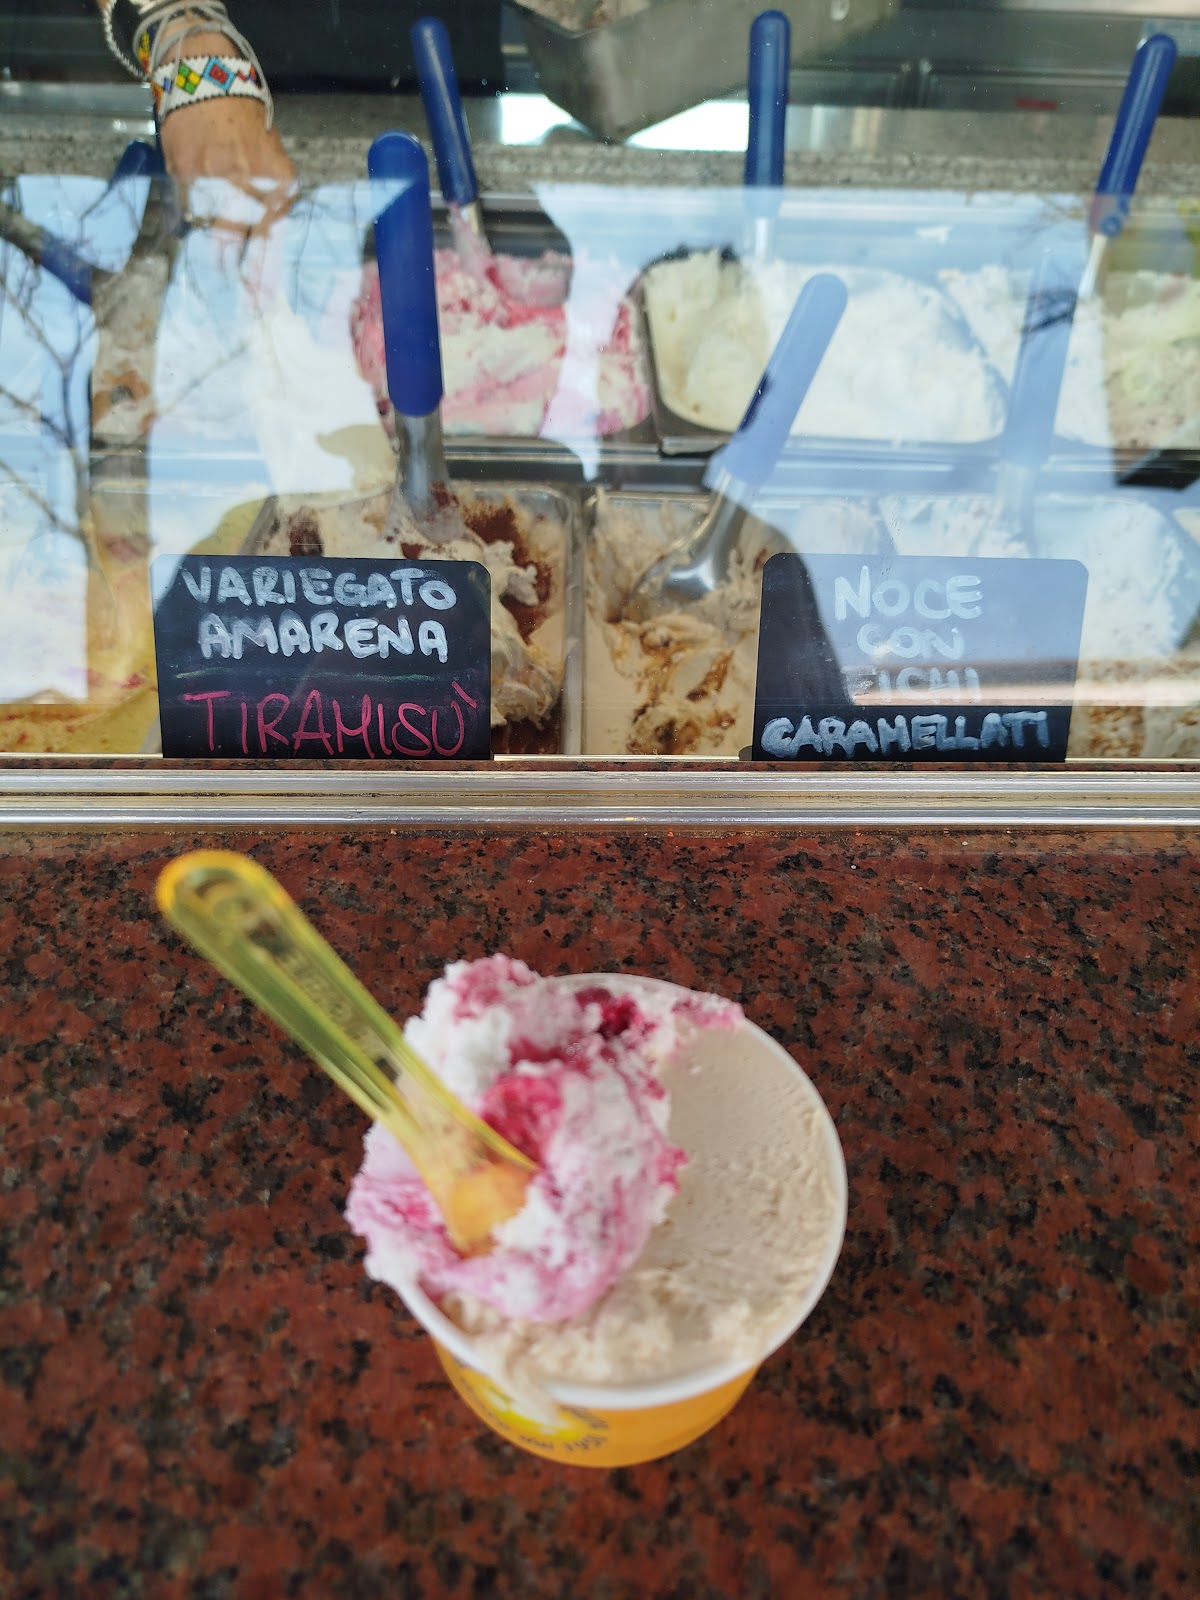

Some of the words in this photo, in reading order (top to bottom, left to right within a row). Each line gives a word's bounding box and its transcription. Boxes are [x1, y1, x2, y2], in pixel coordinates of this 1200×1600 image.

[180, 566, 458, 611] VARIEGATO
[833, 565, 984, 621] NOCE
[198, 610, 449, 663] AMARENA
[857, 622, 965, 661] CON
[760, 710, 1050, 759] CARAMELLATI
